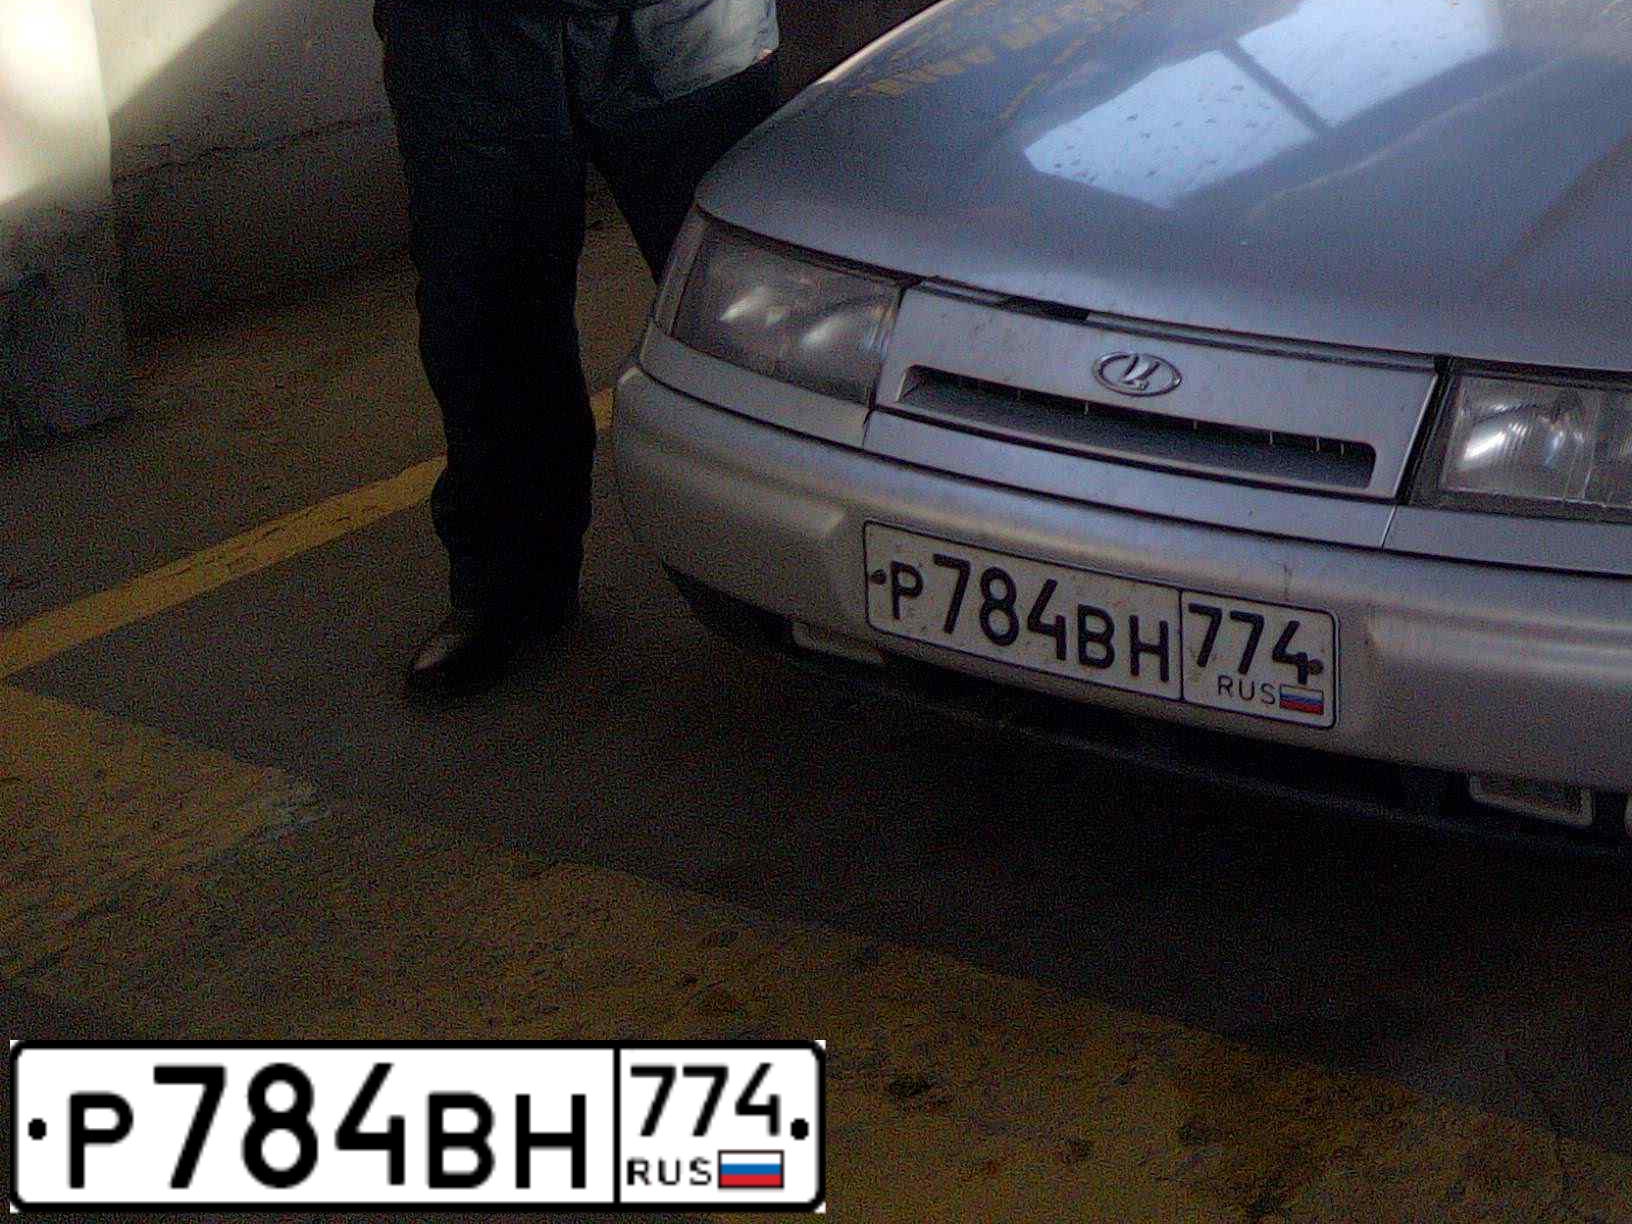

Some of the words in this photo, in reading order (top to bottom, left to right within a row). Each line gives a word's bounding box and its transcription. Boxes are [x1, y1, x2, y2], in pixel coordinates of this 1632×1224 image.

[889, 553, 1170, 682] Р784ВН
[1188, 601, 1309, 684] 774
[1217, 675, 1276, 706] RUS
